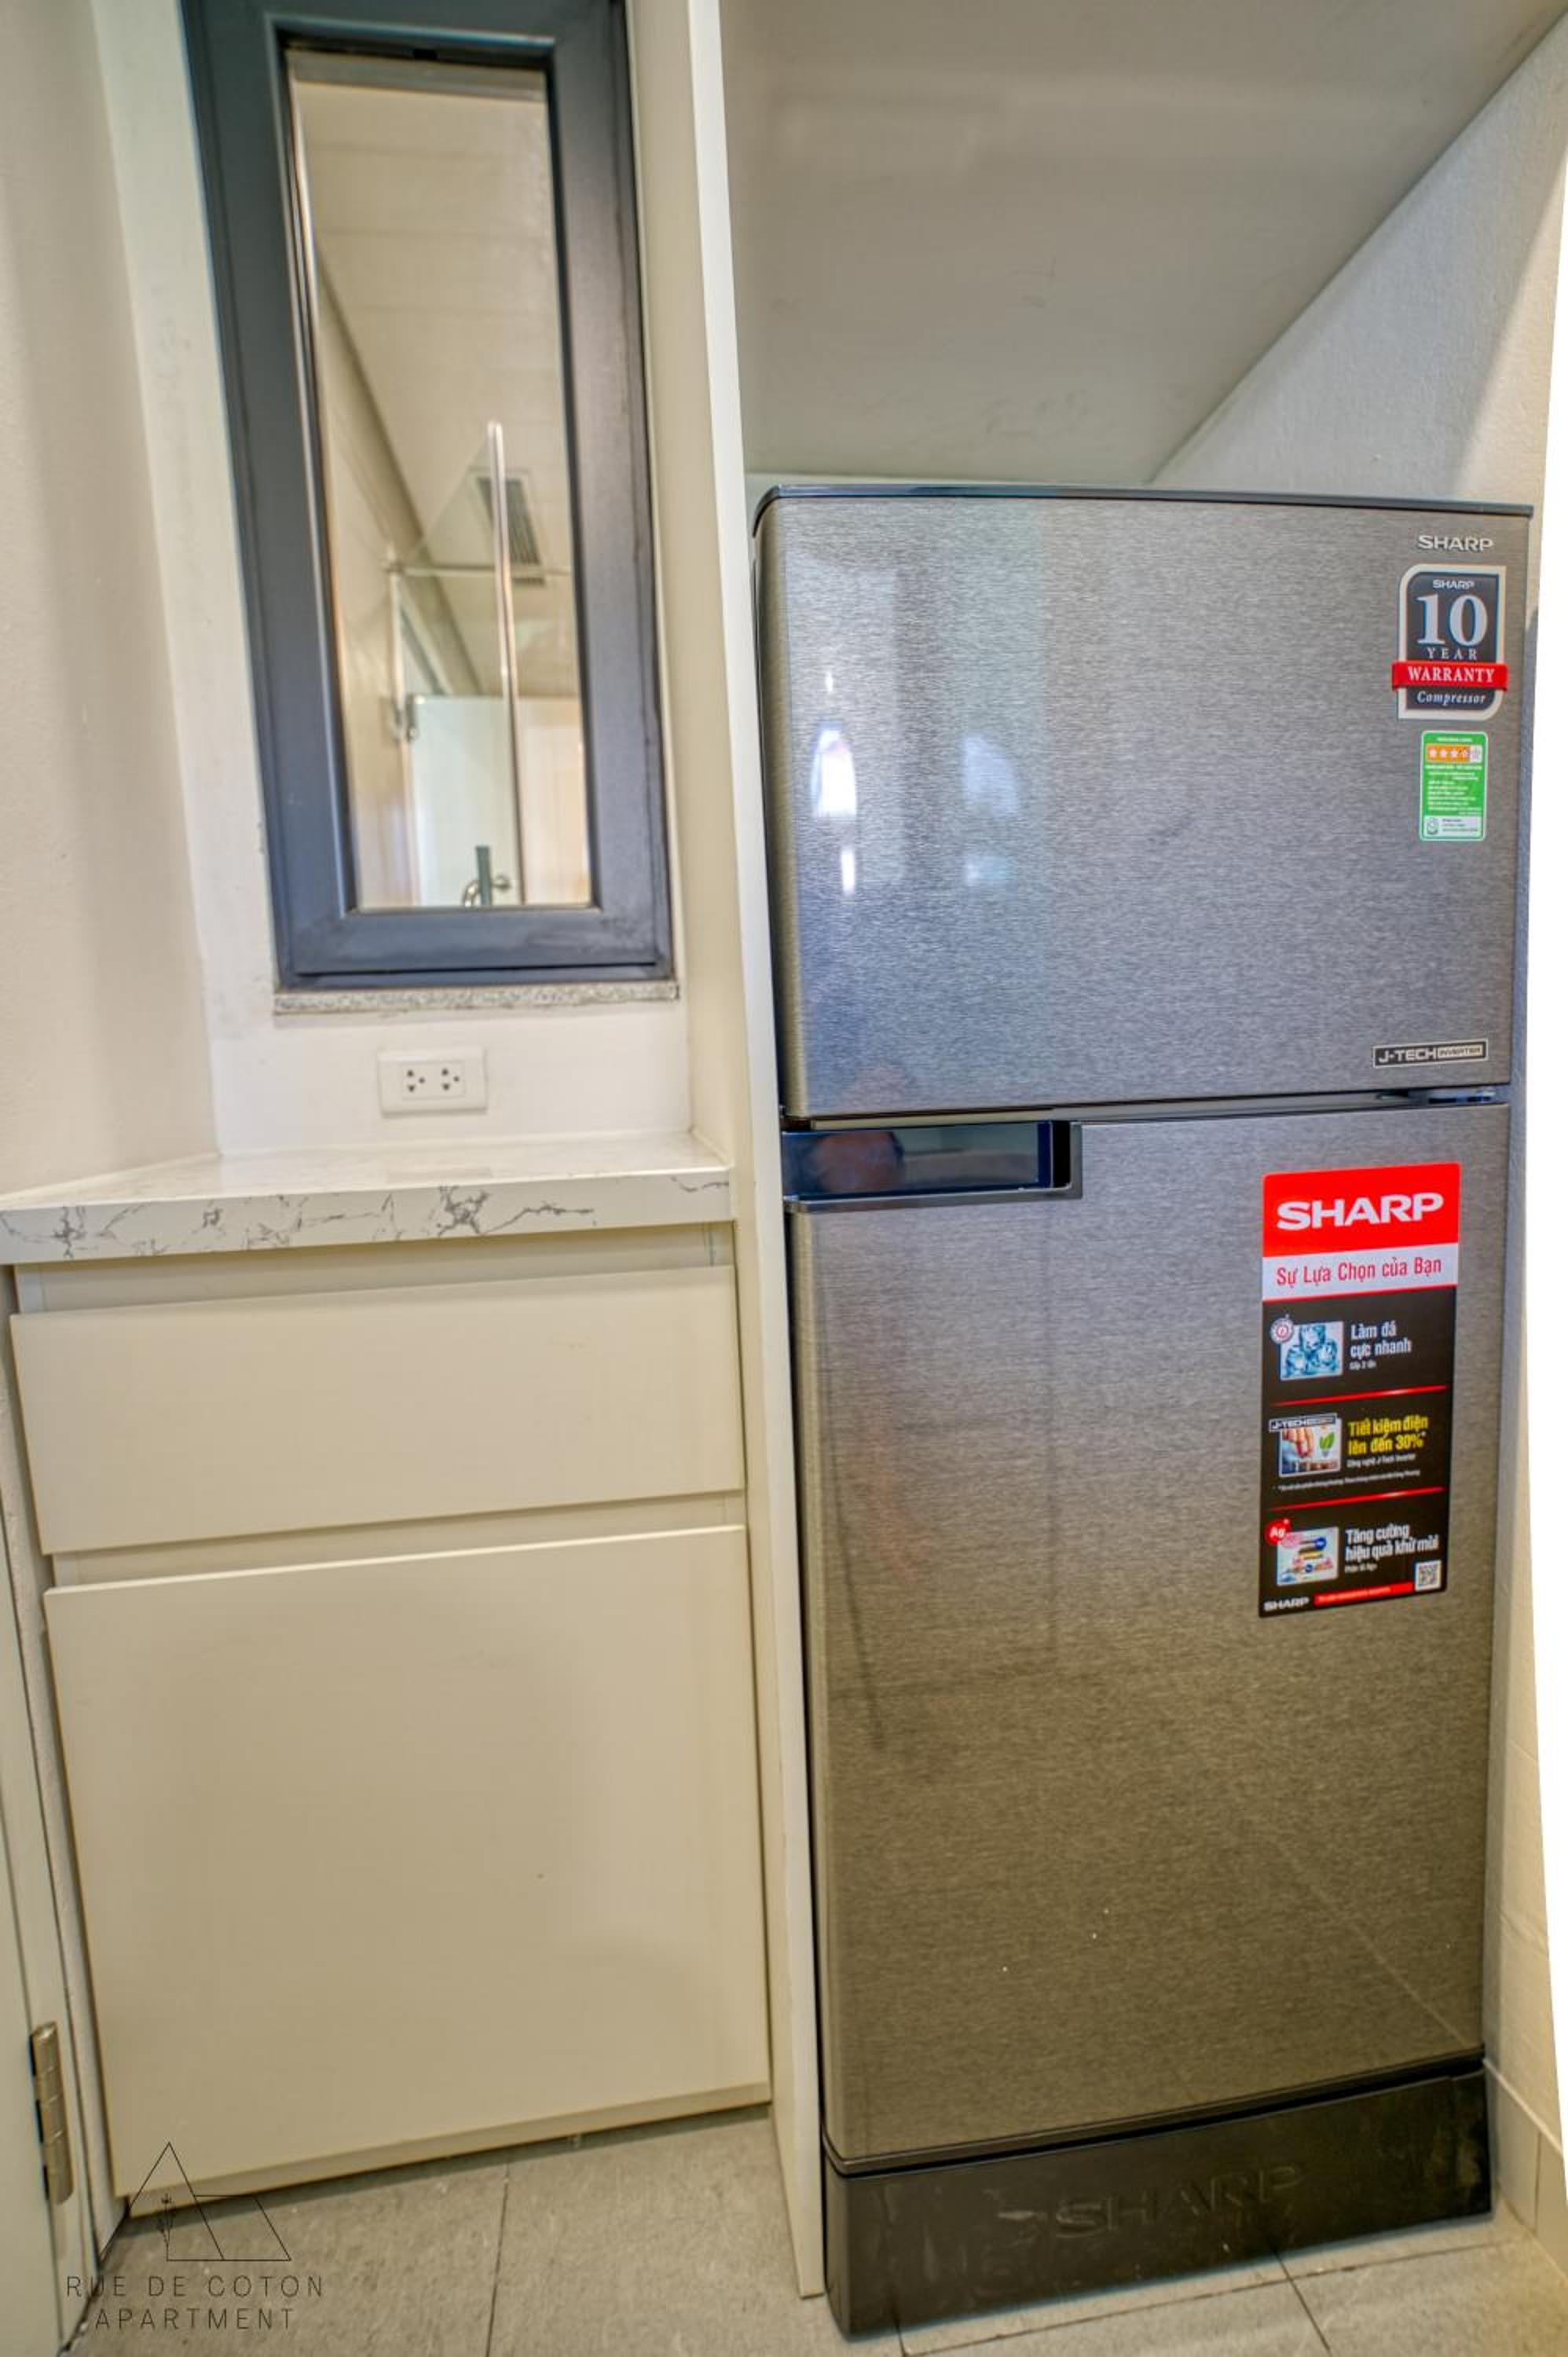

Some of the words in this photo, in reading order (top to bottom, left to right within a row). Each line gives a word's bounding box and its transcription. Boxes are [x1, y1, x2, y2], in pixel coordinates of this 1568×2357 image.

[1418, 534, 1493, 552] SHARP
[1433, 579, 1475, 589] SHARP
[1416, 594, 1488, 646] 10
[1427, 647, 1477, 660] YEAR
[1407, 666, 1495, 683] WARRANTY
[1417, 691, 1486, 706] Compressor
[1277, 1192, 1444, 1230] SHARP
[1277, 1267, 1298, 1288] Sự
[1303, 1263, 1331, 1286] Lựa
[1338, 1262, 1375, 1282] Chọn
[1382, 1257, 1407, 1277] của
[1414, 1256, 1441, 1277] Bạn
[1350, 1324, 1377, 1340] Làm
[1381, 1321, 1397, 1336] đá
[1375, 1338, 1412, 1355] nhanh
[1348, 1418, 1372, 1437] Tiết
[1372, 1417, 1401, 1435] kiệm
[1402, 1415, 1428, 1433] điện
[1349, 1439, 1367, 1456] lên
[1370, 1434, 1393, 1453] đến
[1346, 1527, 1373, 1545] Tăng
[1263, 1596, 1309, 1611] SHARP
[1055, 2165, 1304, 2239] SHARP
